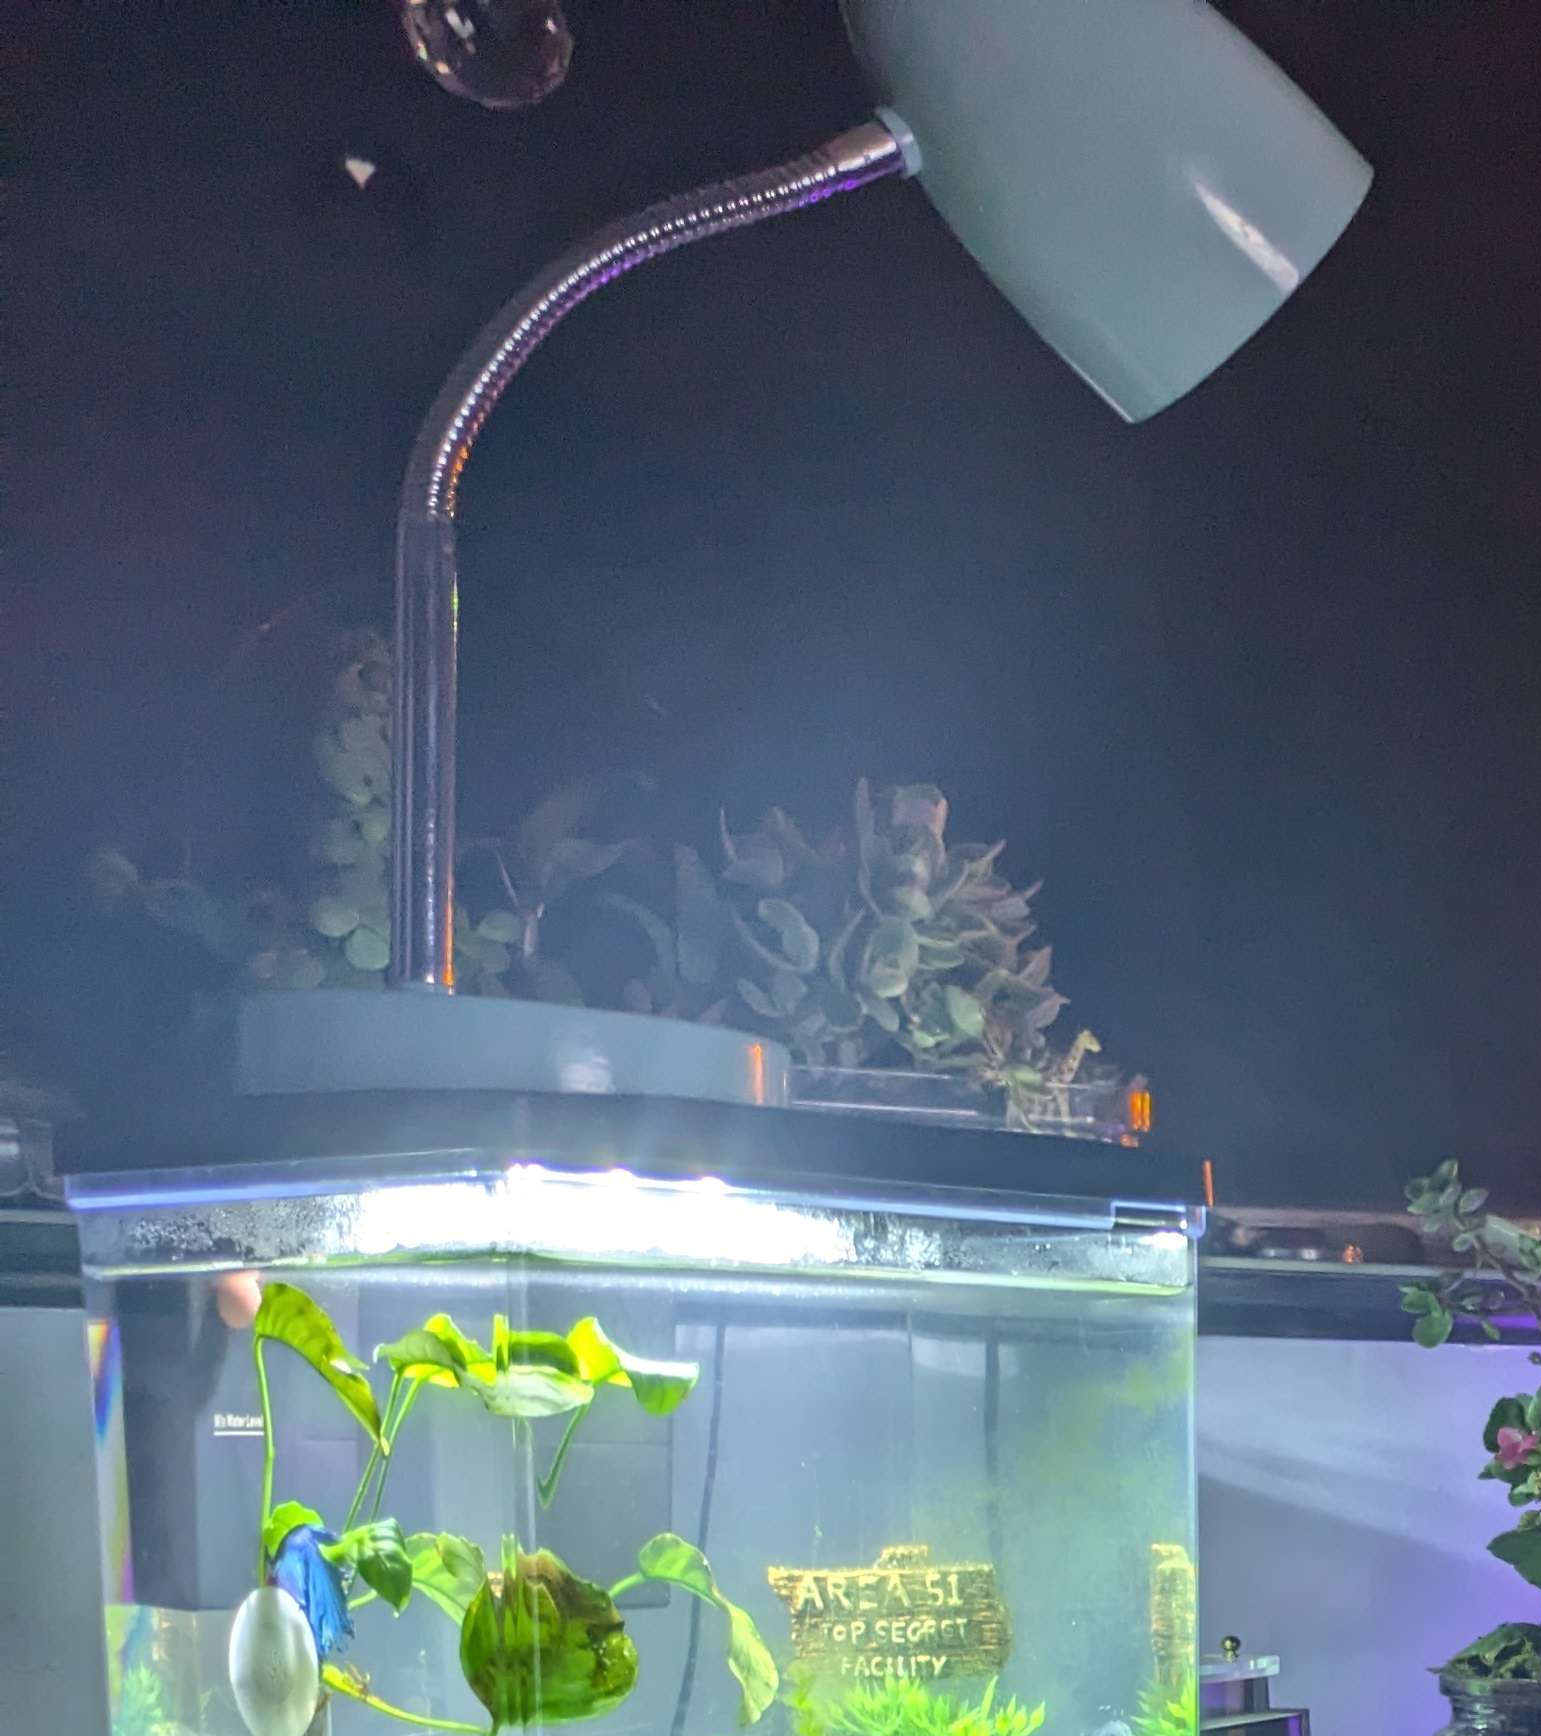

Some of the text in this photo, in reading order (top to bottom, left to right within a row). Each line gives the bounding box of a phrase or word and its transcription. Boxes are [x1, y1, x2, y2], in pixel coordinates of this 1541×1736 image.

[797, 1569, 964, 1610] AREA 51
[822, 1617, 968, 1645] TOP SECRET
[841, 1655, 948, 1678] FACILITY
